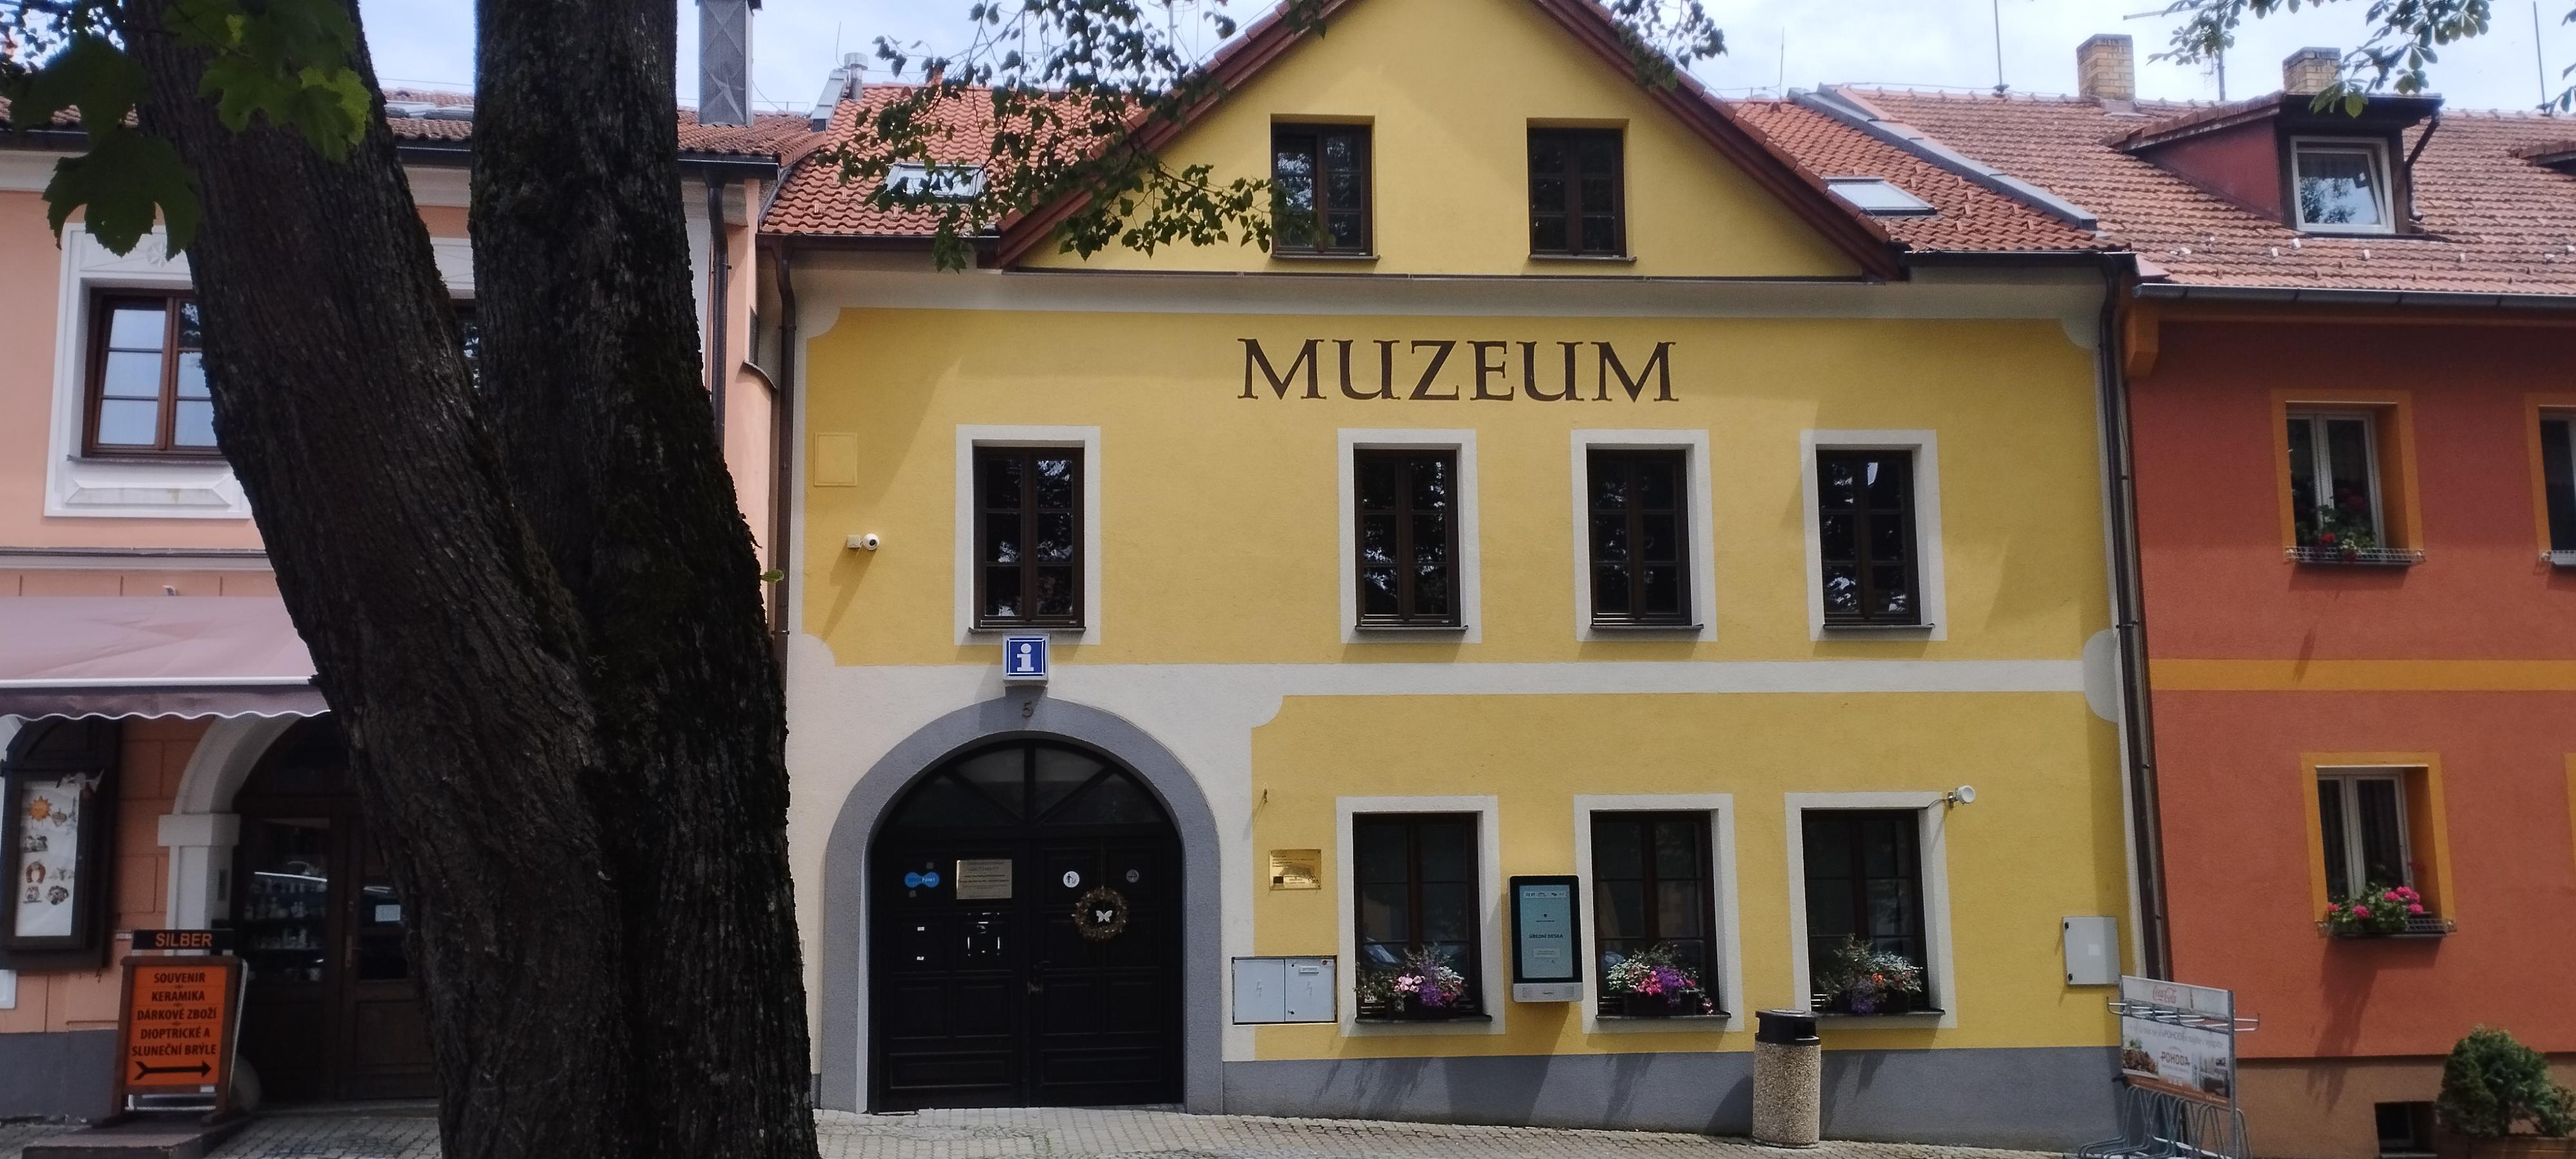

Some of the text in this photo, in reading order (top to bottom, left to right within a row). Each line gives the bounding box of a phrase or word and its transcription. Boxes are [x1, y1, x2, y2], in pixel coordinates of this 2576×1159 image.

[1237, 337, 1680, 403] MUZEUM
[1021, 701, 1034, 718] 5
[155, 932, 213, 947] SILBER
[154, 972, 206, 983] SOUVENIR
[151, 990, 205, 1002] KERAMIKA
[137, 1006, 218, 1021] DÁRKOVÉ ZBOŽÍ
[140, 1025, 210, 1040] DIOPTRICKÉ A
[132, 1042, 216, 1057] SLUNEČNÍ BRÝLE
[2160, 1051, 2191, 1067] POHODA
